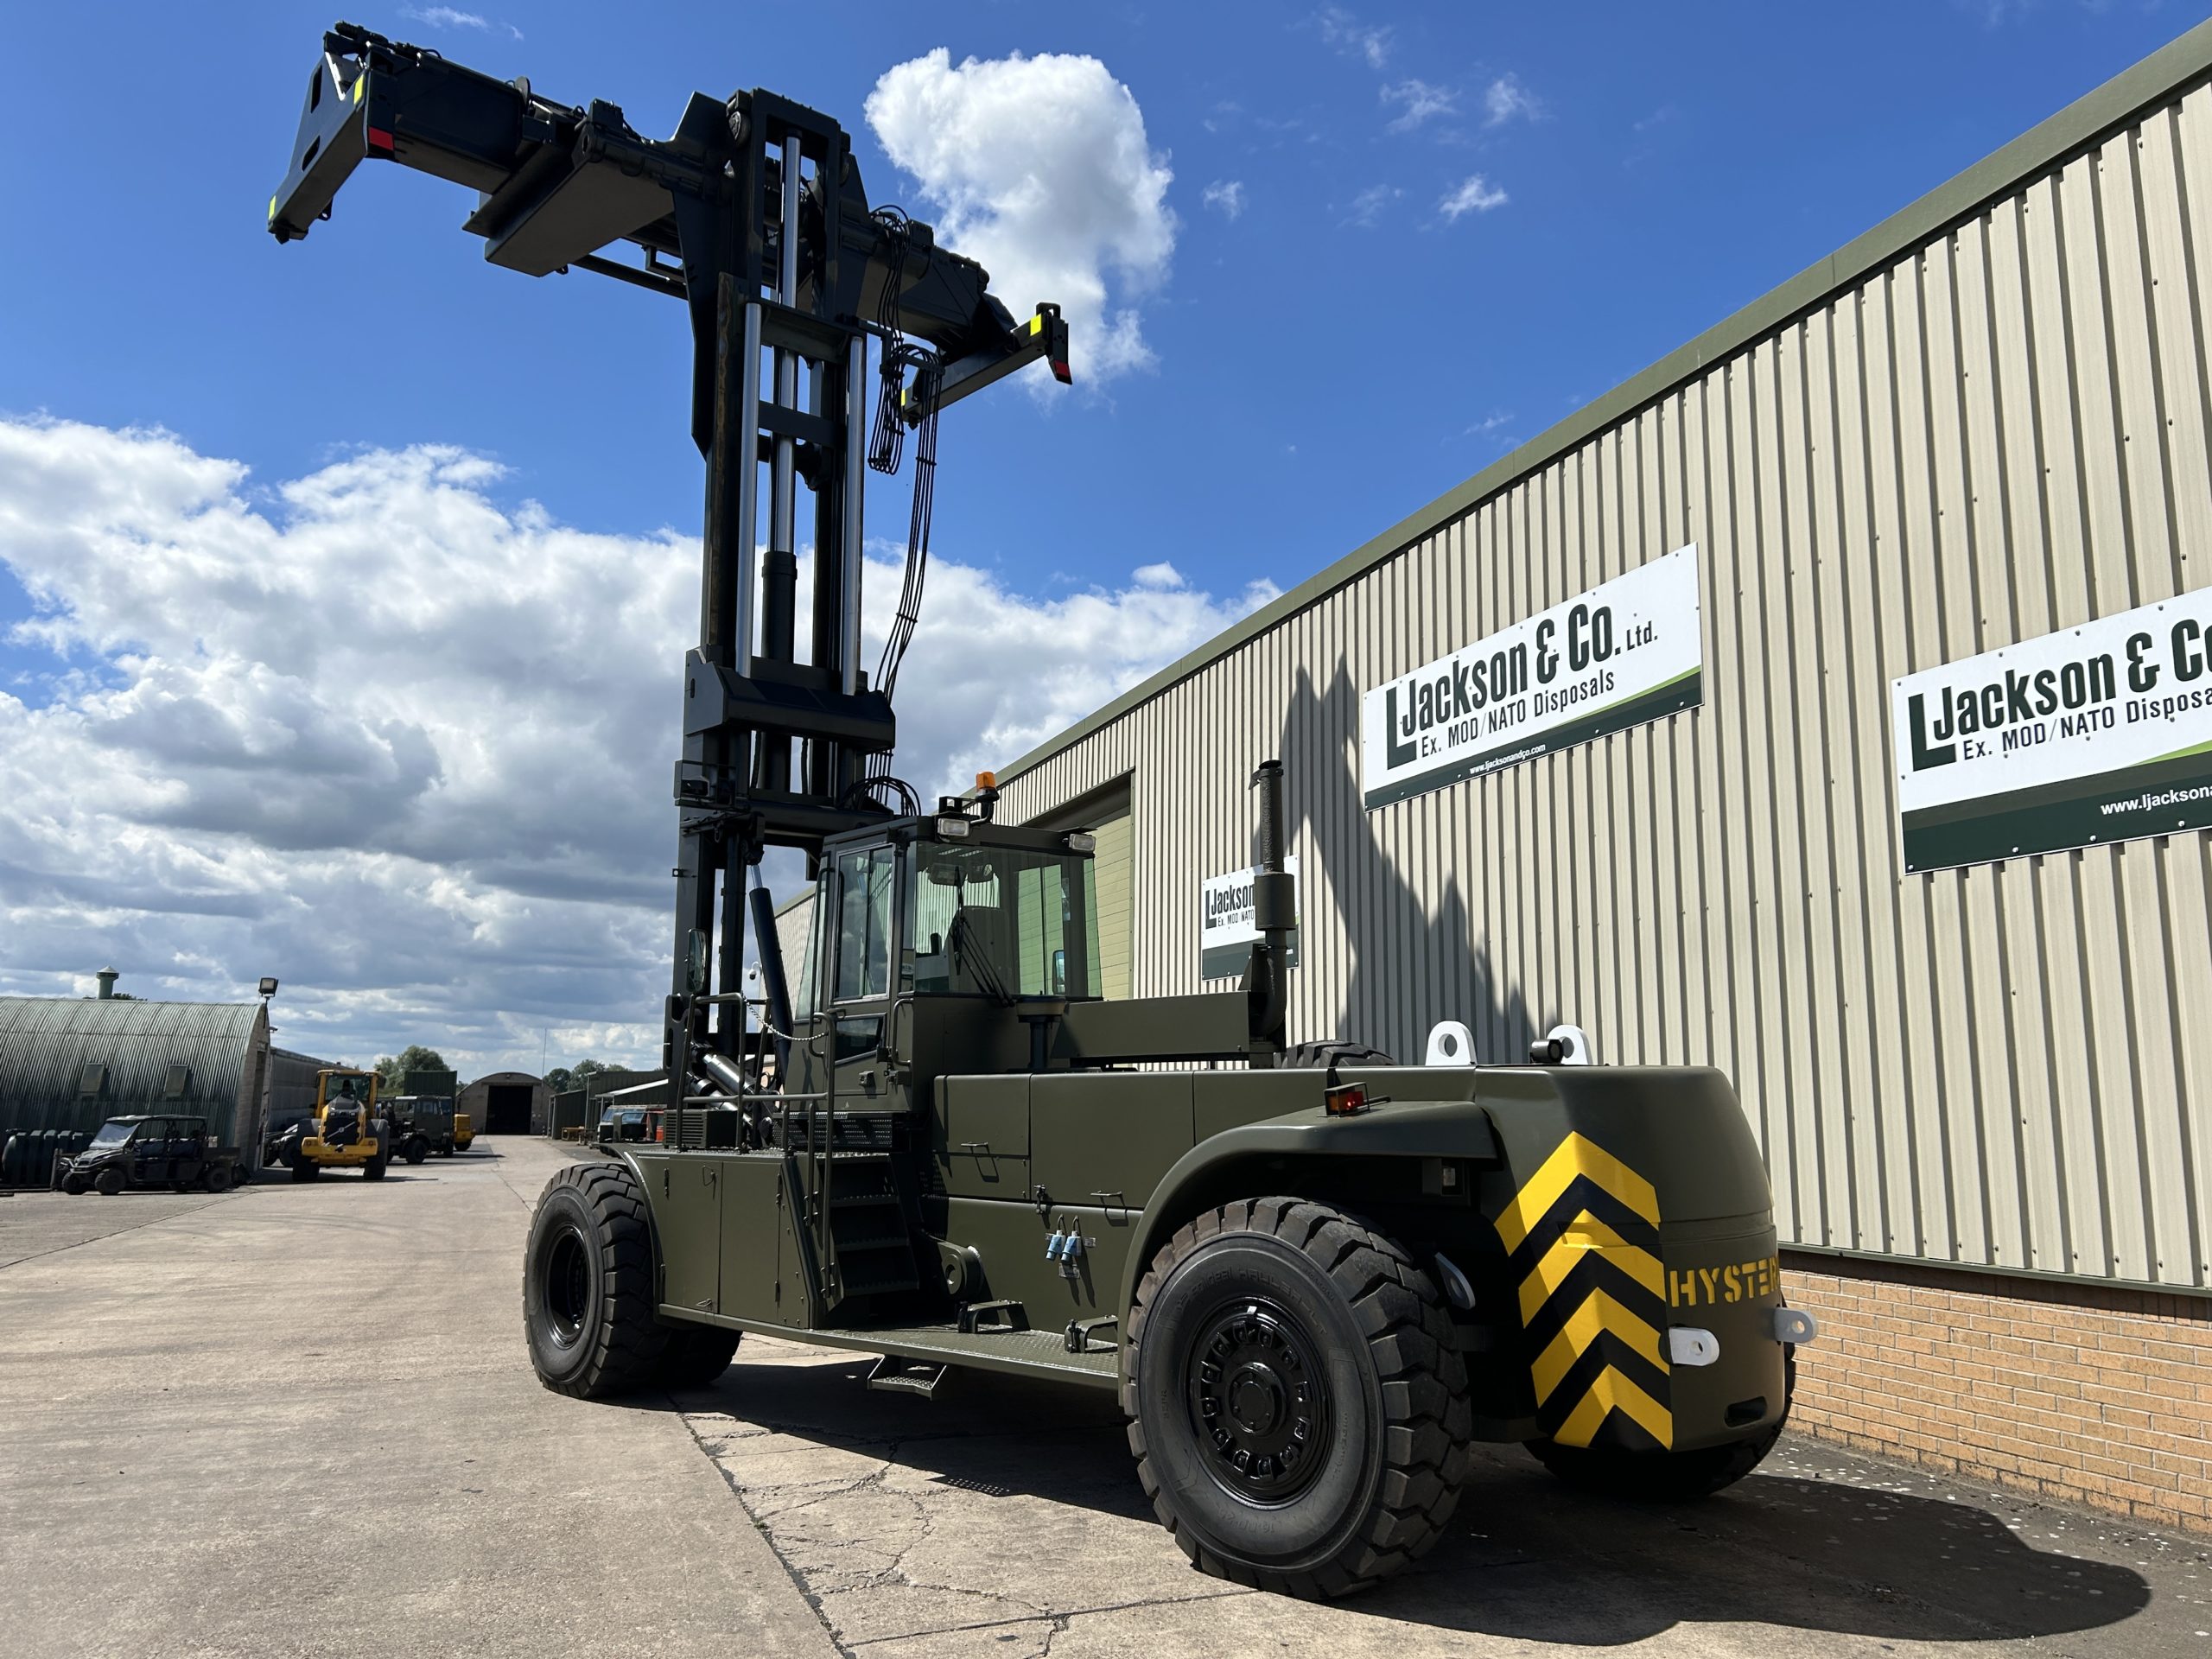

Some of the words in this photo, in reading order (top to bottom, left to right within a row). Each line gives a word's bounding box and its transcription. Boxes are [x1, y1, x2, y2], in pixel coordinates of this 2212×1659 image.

[1536, 618, 1559, 684] &
[1568, 603, 1621, 671] Co.
[1627, 620, 1658, 651] Ltd.
[2126, 632, 2161, 693] &
[2171, 619, 2212, 682] C
[1421, 734, 1441, 758] Ex.
[1534, 671, 1615, 717] Disposals
[1962, 740, 1993, 761] Ex.
[2101, 785, 2212, 816] www.ljackson
